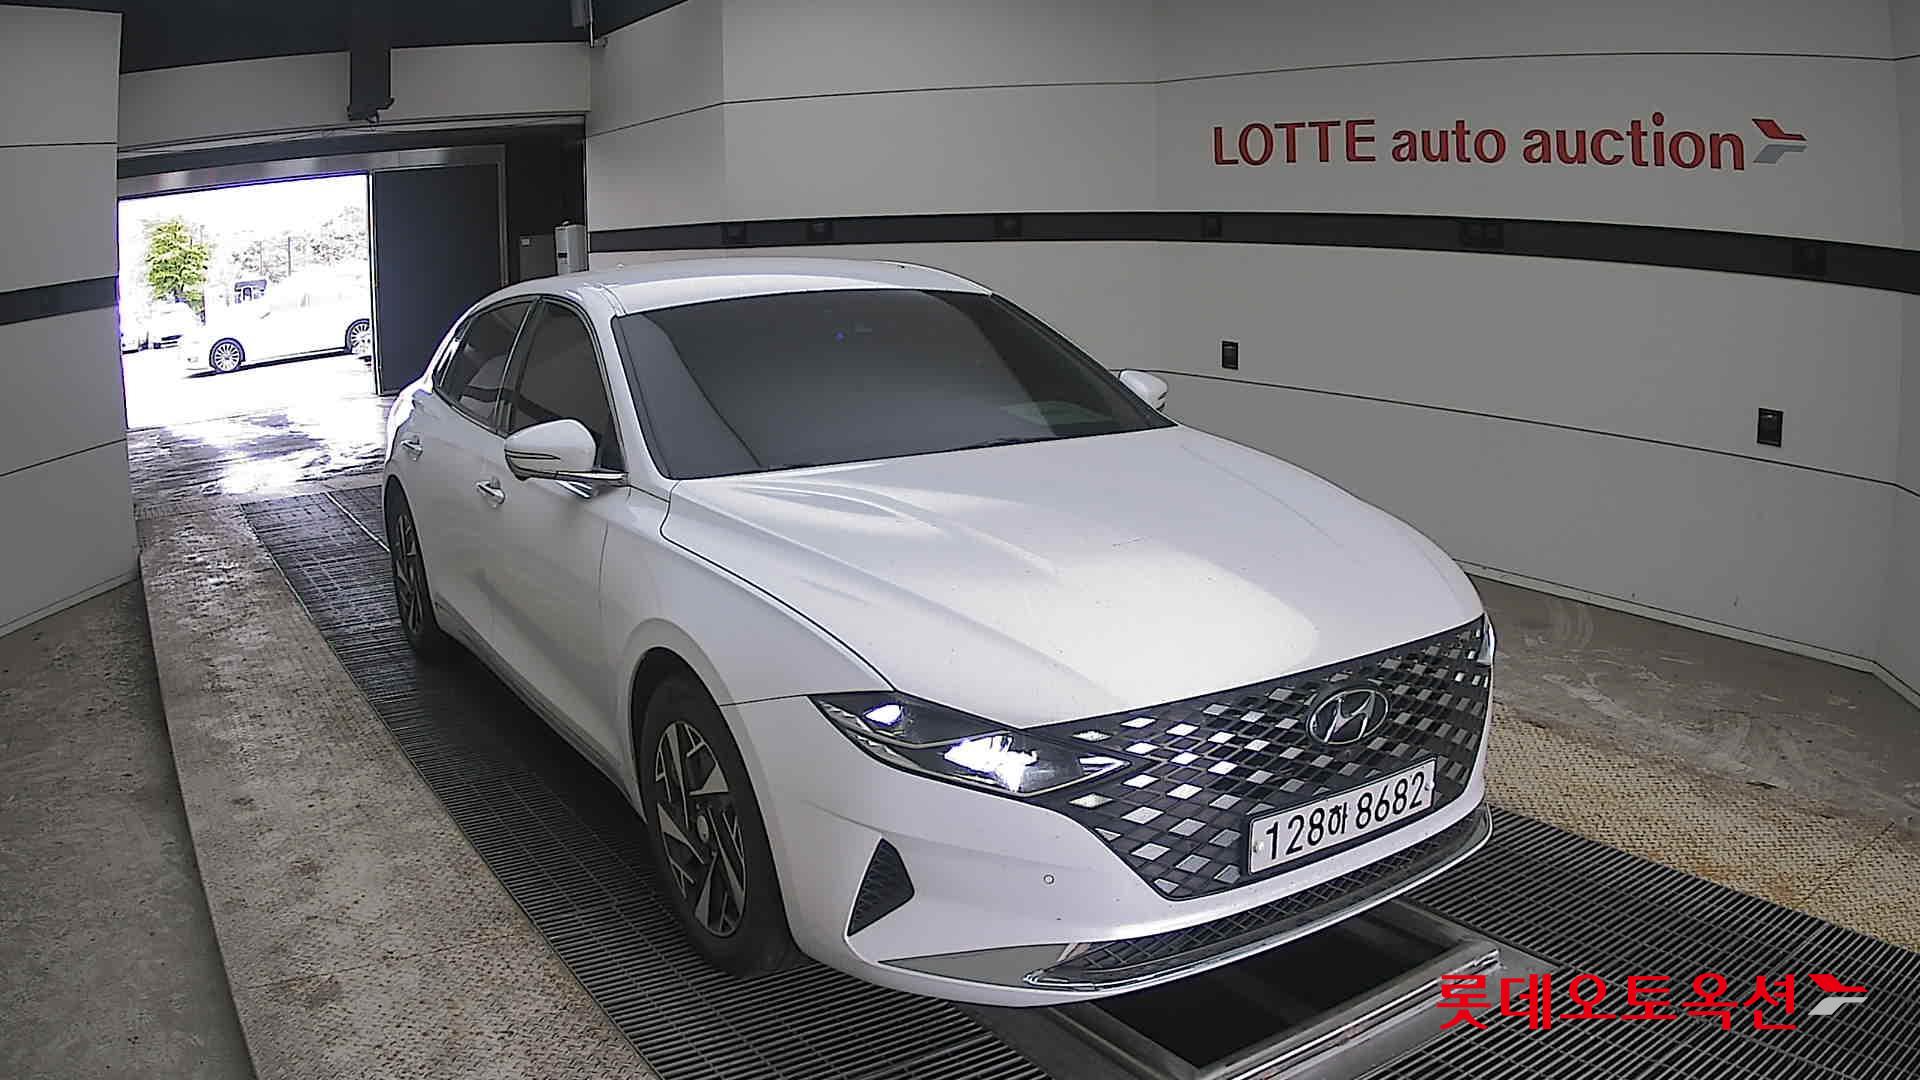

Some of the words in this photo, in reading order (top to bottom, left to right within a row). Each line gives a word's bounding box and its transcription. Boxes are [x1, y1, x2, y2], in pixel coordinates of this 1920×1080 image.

[1212, 118, 1377, 167] LOTTE
[1391, 119, 1507, 164] auto
[1522, 111, 1746, 172] auction
[1265, 801, 1348, 860] 128하
[1355, 770, 1425, 830] 8682
